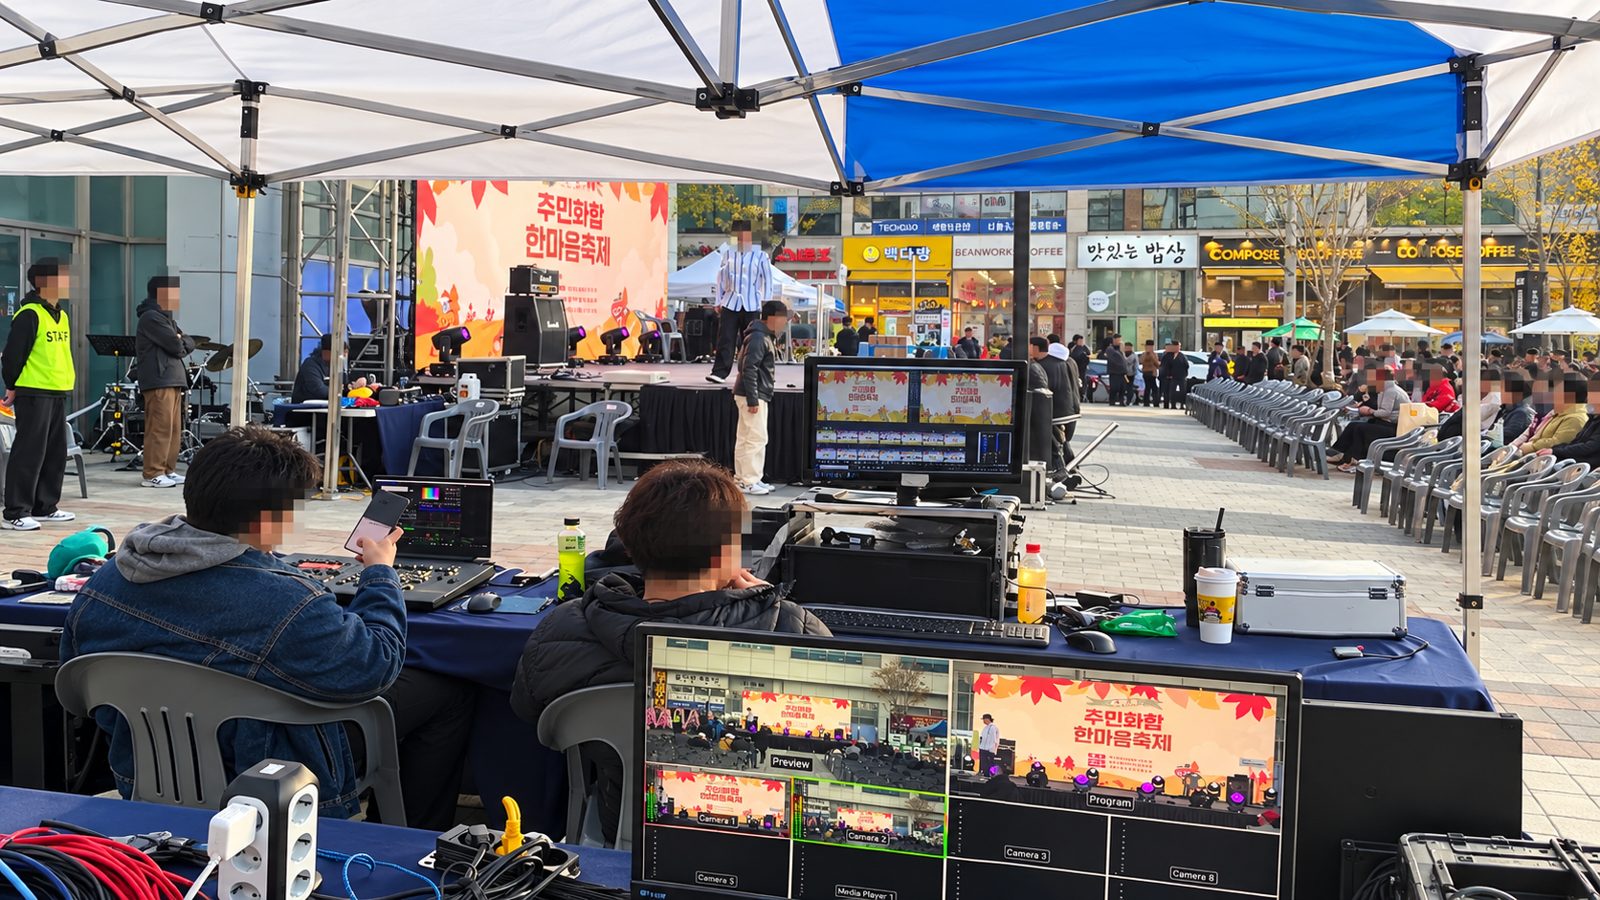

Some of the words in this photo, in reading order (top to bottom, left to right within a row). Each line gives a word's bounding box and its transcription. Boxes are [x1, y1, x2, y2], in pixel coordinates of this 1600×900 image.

[525, 224, 611, 267] 한마음축제
[955, 248, 1014, 257] BEANWORK
[1030, 247, 1063, 256] OFFEE
[884, 246, 931, 262] 백다방
[1087, 242, 1138, 262] 맛있는
[1145, 241, 1186, 264] 밥상
[1074, 725, 1172, 752] 한마음축제
[772, 756, 810, 769] Preview
[1090, 795, 1132, 808] Program
[699, 814, 729, 825] Camera
[881, 835, 887, 843] 2
[1006, 848, 1039, 859] Camera
[1041, 852, 1047, 861] 3
[697, 874, 728, 884] Camera
[1172, 869, 1206, 881] Camera
[1208, 873, 1215, 882] 8
[862, 890, 888, 900] Player
